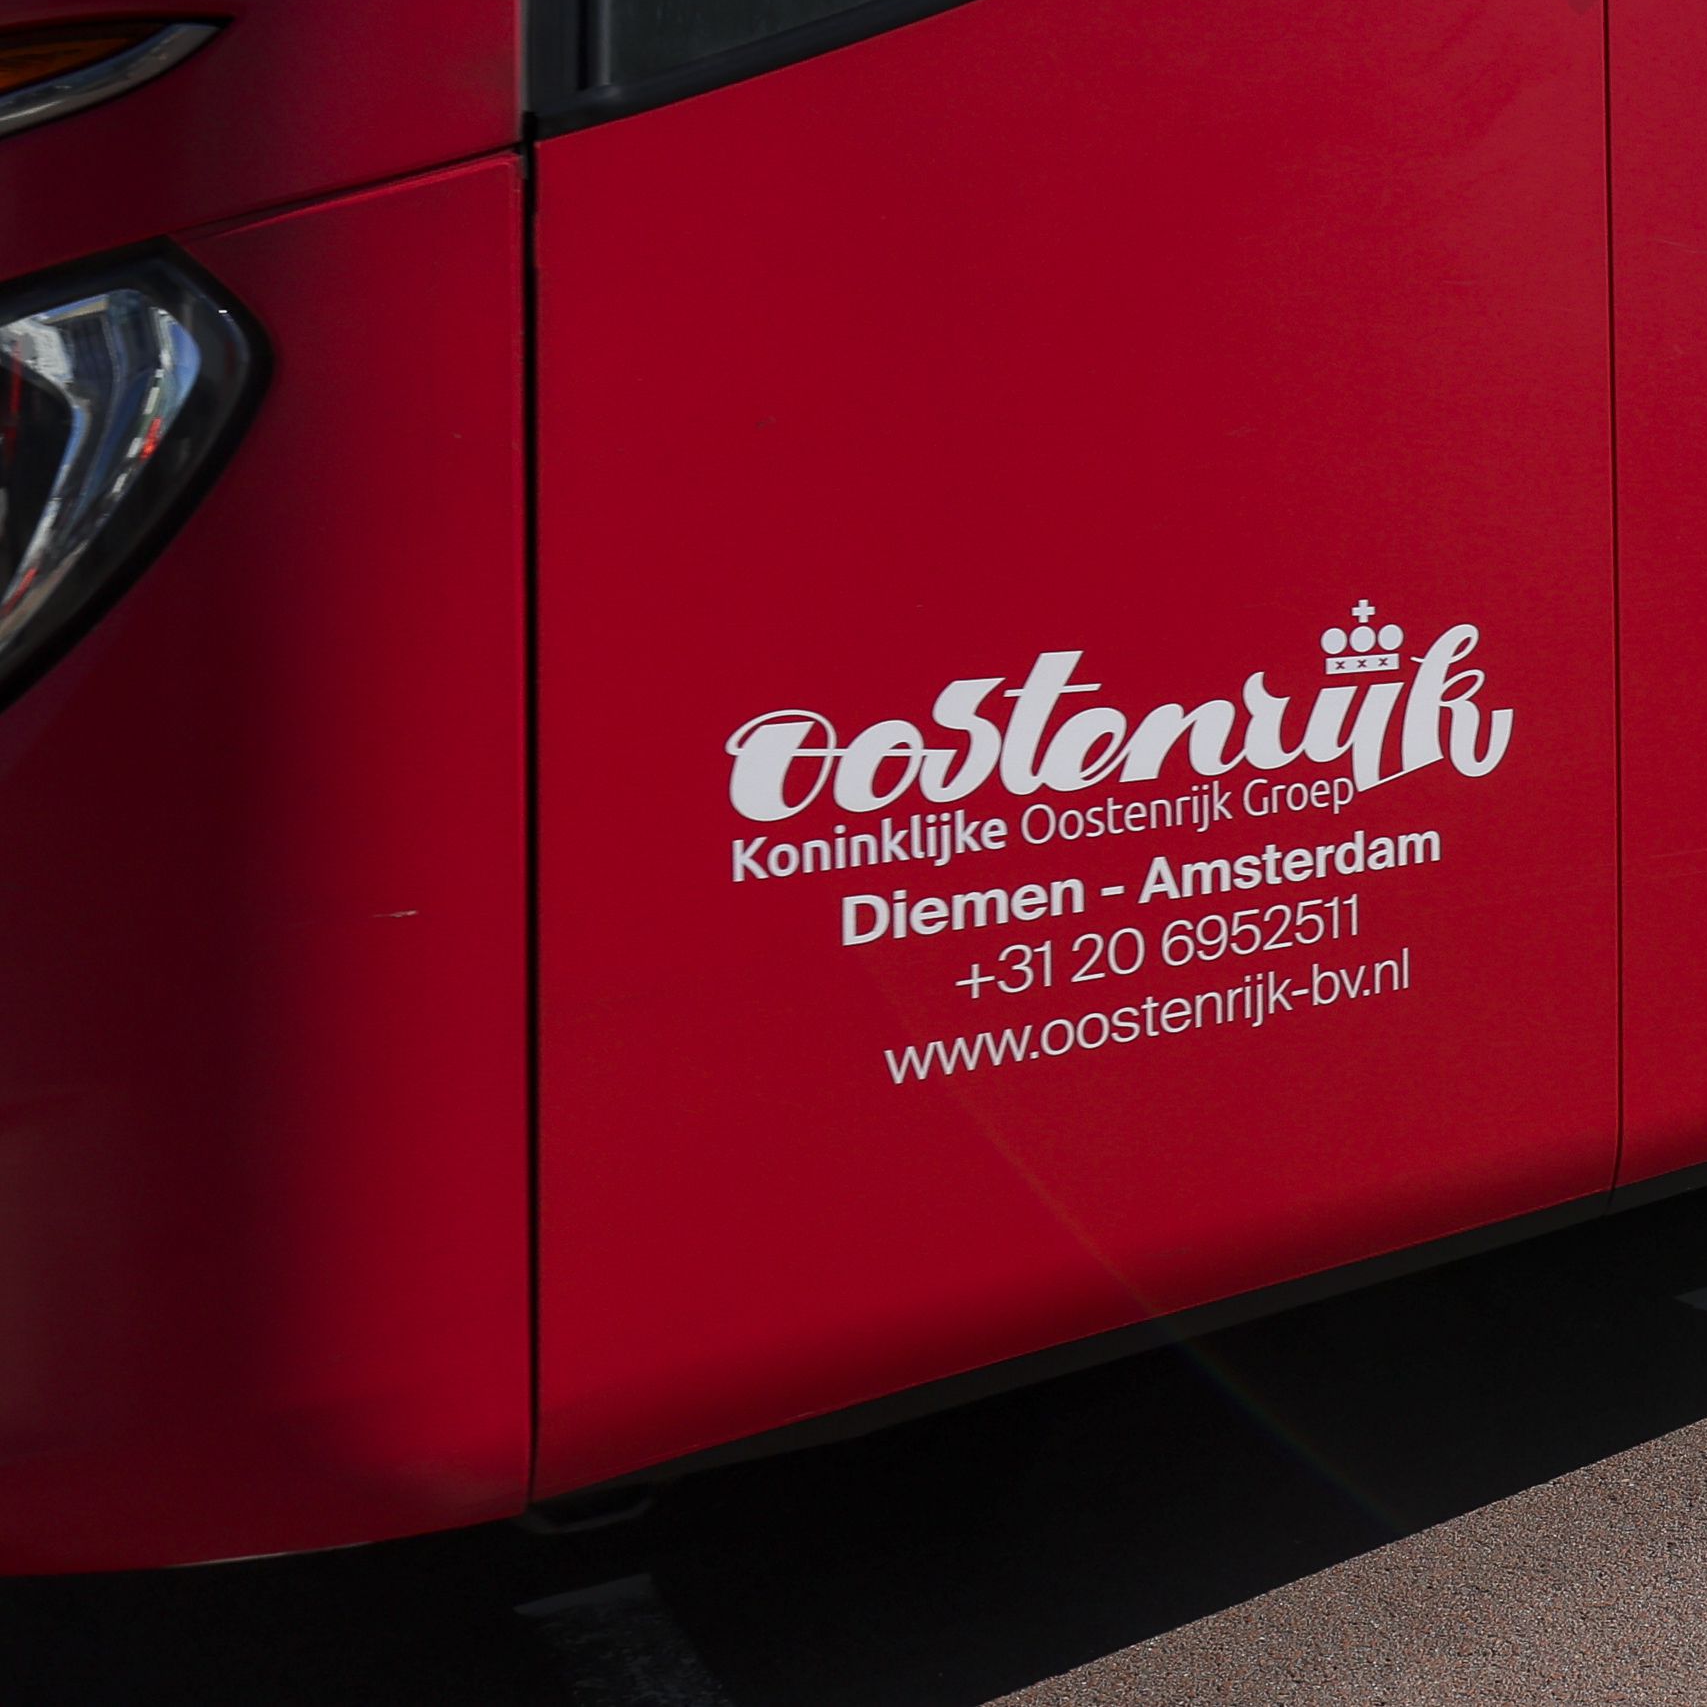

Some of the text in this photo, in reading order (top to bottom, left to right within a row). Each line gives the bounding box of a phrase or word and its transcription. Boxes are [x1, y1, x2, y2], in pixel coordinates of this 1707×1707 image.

[732, 776, 1354, 882] Koninklijke Oostenrijk Groep
[841, 877, 1085, 946] Diemen
[1138, 830, 1442, 906] Amsterdam
[954, 895, 1361, 1000] +31 20 6952511
[883, 949, 1411, 1085] www.oostenrijk-bv.nl
